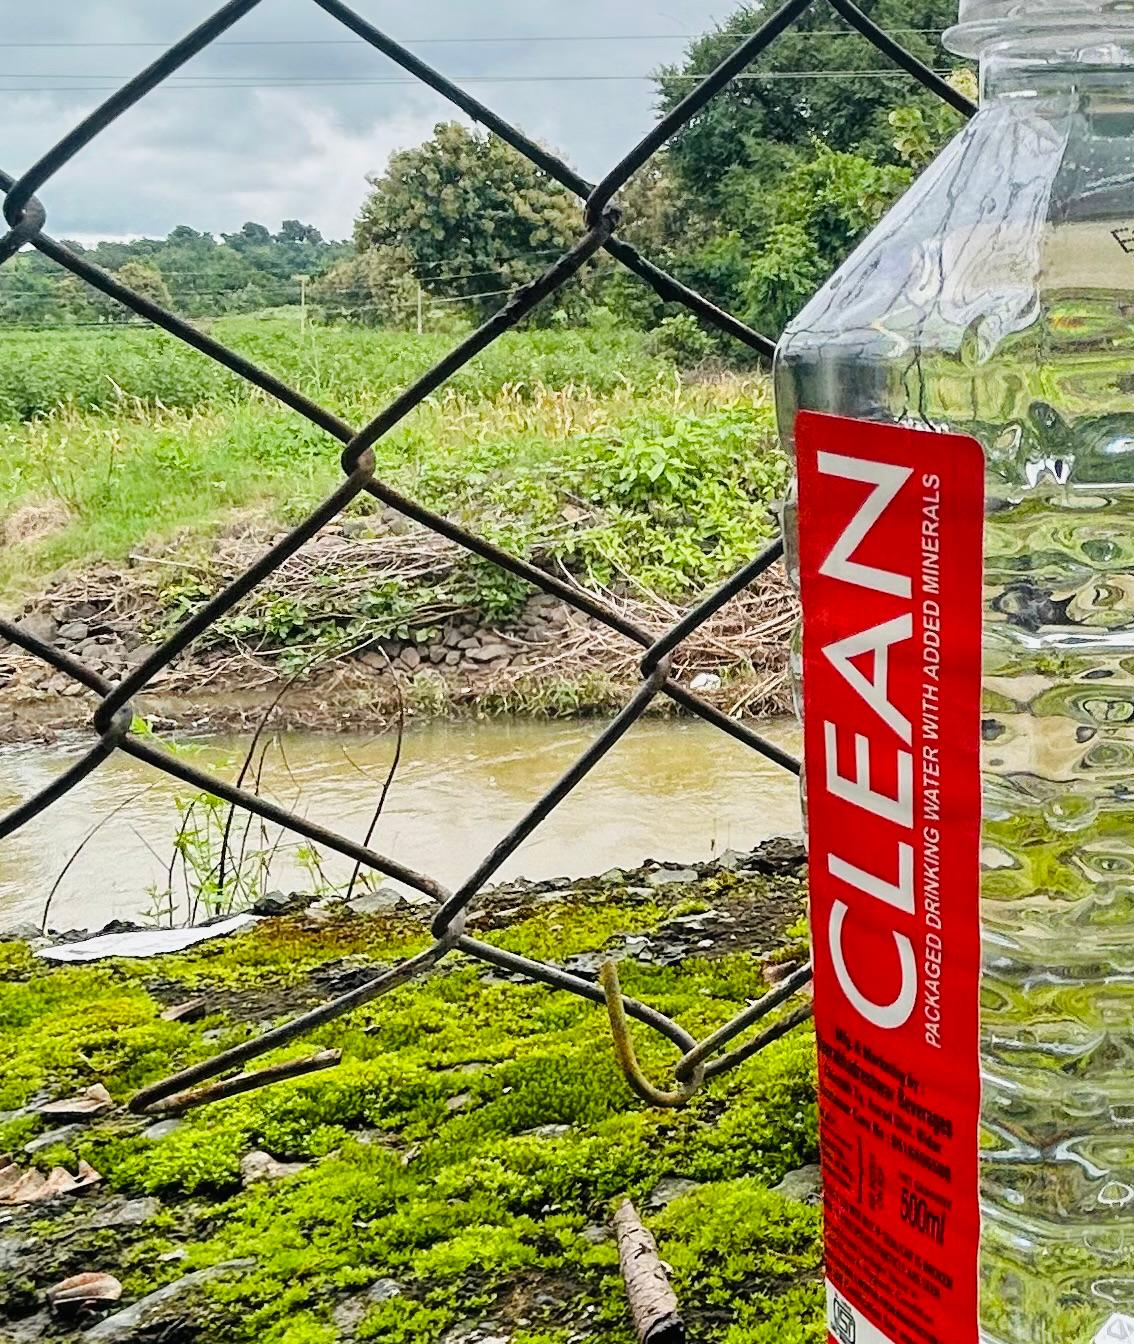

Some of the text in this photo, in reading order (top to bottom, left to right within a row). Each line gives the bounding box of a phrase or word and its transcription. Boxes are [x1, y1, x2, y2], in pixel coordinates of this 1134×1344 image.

[816, 450, 918, 1030] CLEAN
[922, 472, 942, 1049] PACKAGED DRINKING WATER WITH ADDED MINERALS
[900, 1186, 946, 1246] 500ml
